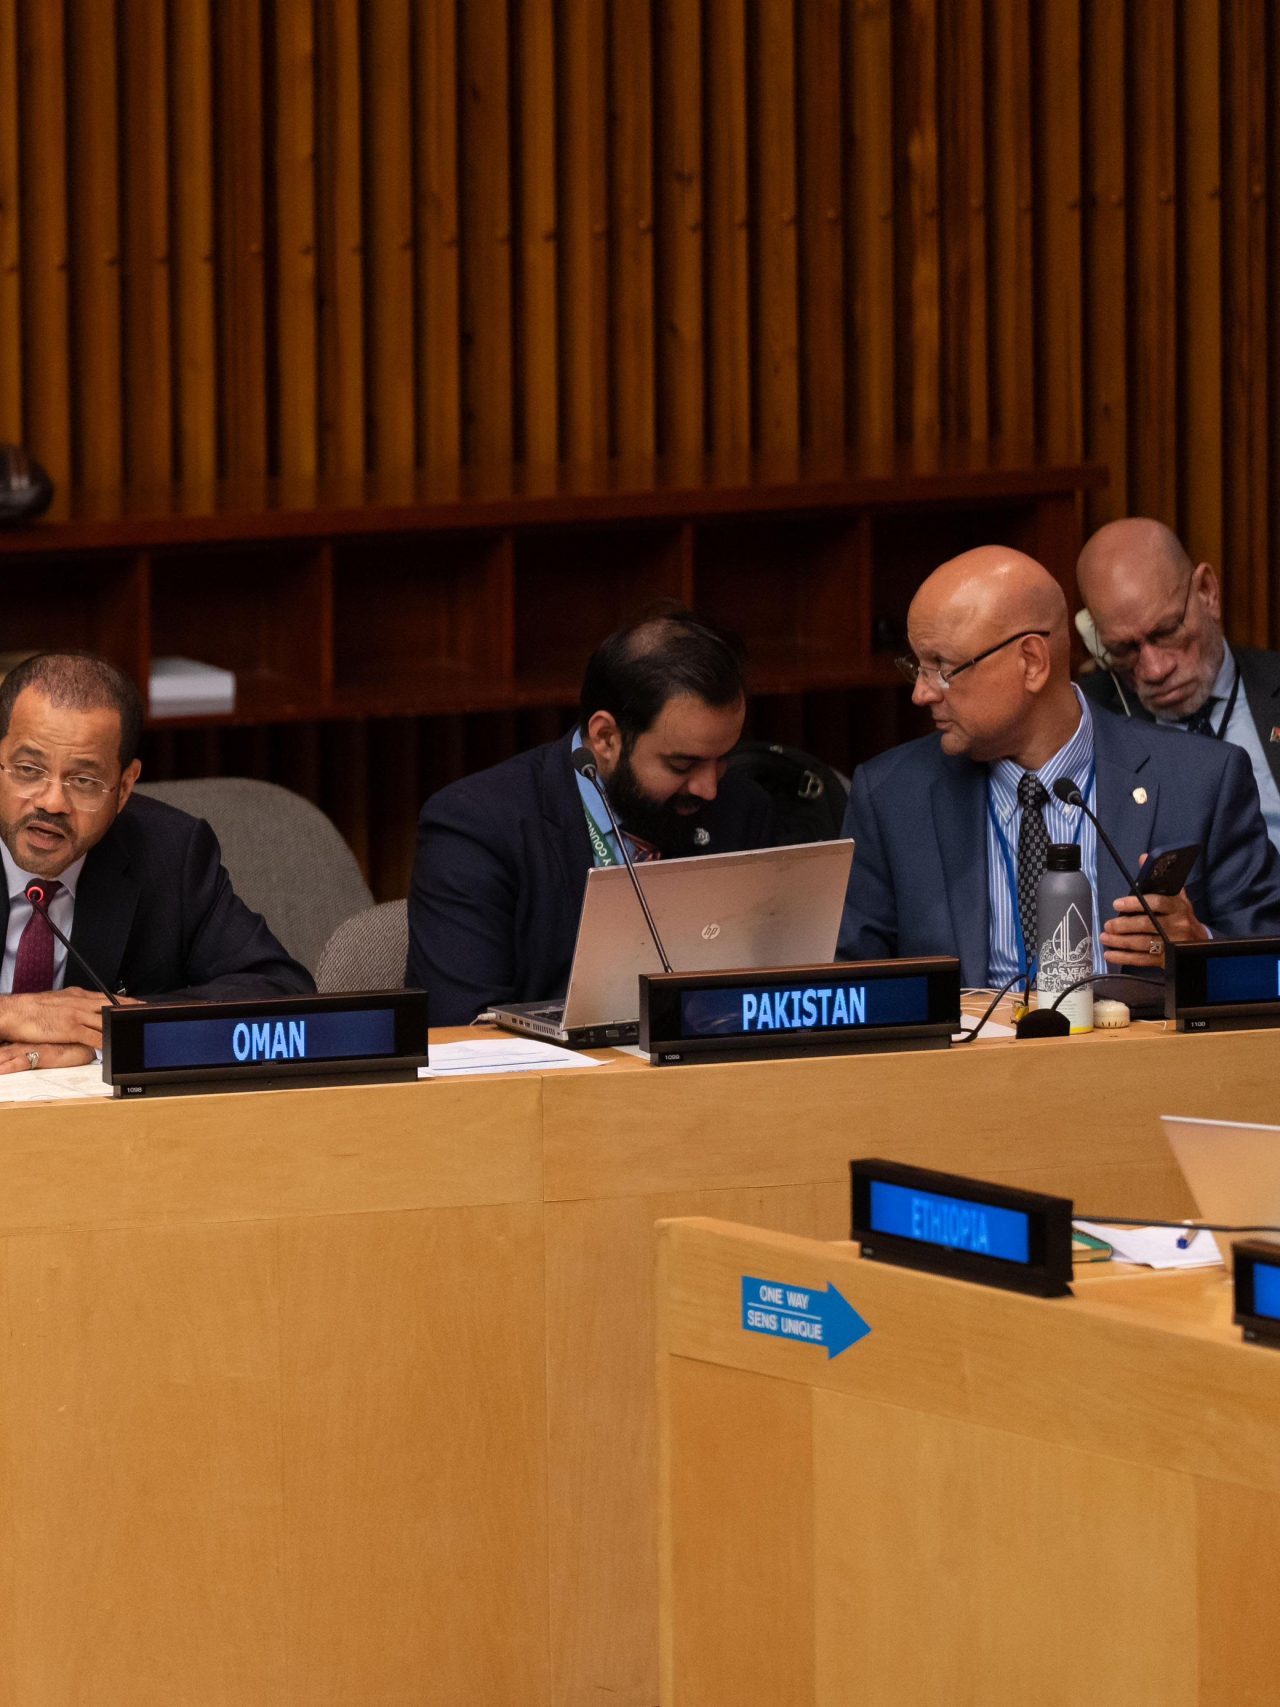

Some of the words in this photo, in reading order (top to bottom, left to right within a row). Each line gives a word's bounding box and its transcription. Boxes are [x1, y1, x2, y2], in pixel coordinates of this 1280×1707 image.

[702, 923, 720, 939] hp
[742, 986, 866, 1031] PAKISTAN
[233, 1020, 306, 1061] OMAN
[911, 1198, 989, 1252] ETHIOPIA
[759, 1285, 783, 1305] ONE
[786, 1291, 809, 1309] WAY
[747, 1310, 778, 1331] SENS
[781, 1317, 823, 1341] UNIQUE
